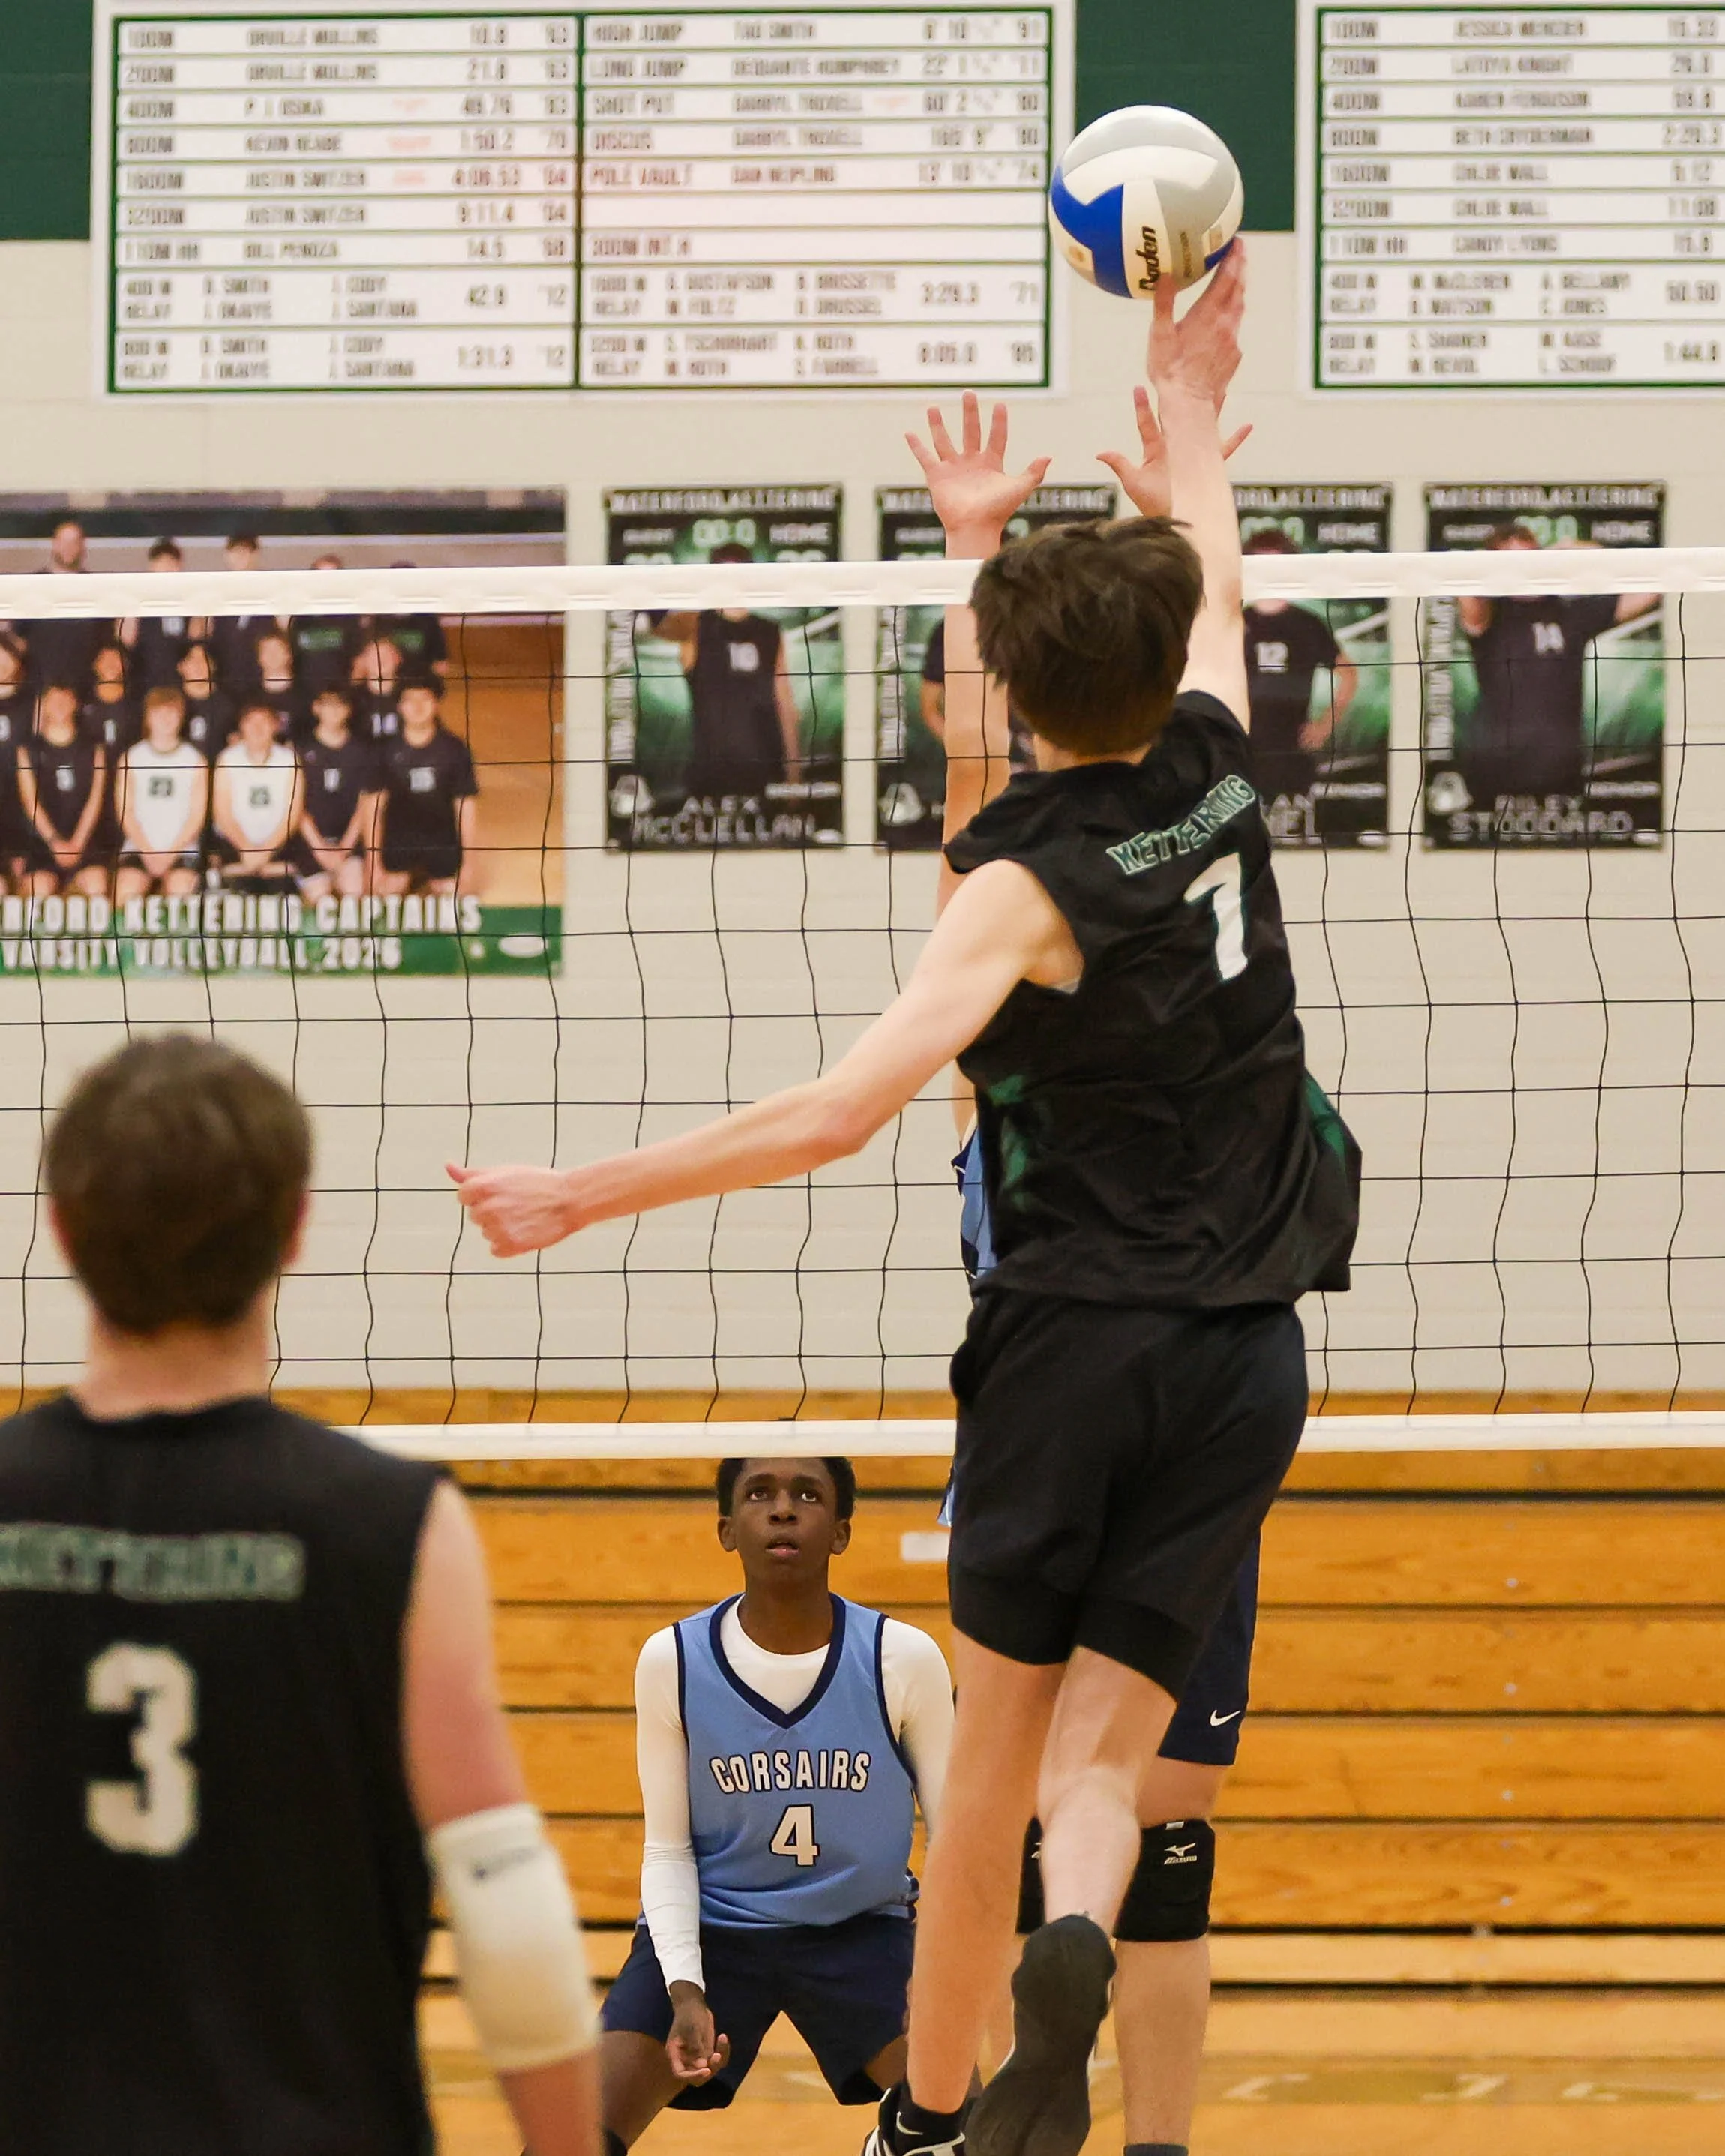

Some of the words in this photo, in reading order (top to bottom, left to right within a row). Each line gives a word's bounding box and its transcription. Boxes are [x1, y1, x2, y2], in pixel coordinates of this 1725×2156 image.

[681, 795, 759, 813] ALEX
[1106, 774, 1257, 876] KETTERING
[315, 892, 482, 934] CAPTAINS
[86, 1642, 199, 1856] 3
[710, 1748, 872, 1794] CORSAIRS
[770, 1802, 820, 1867] 4
